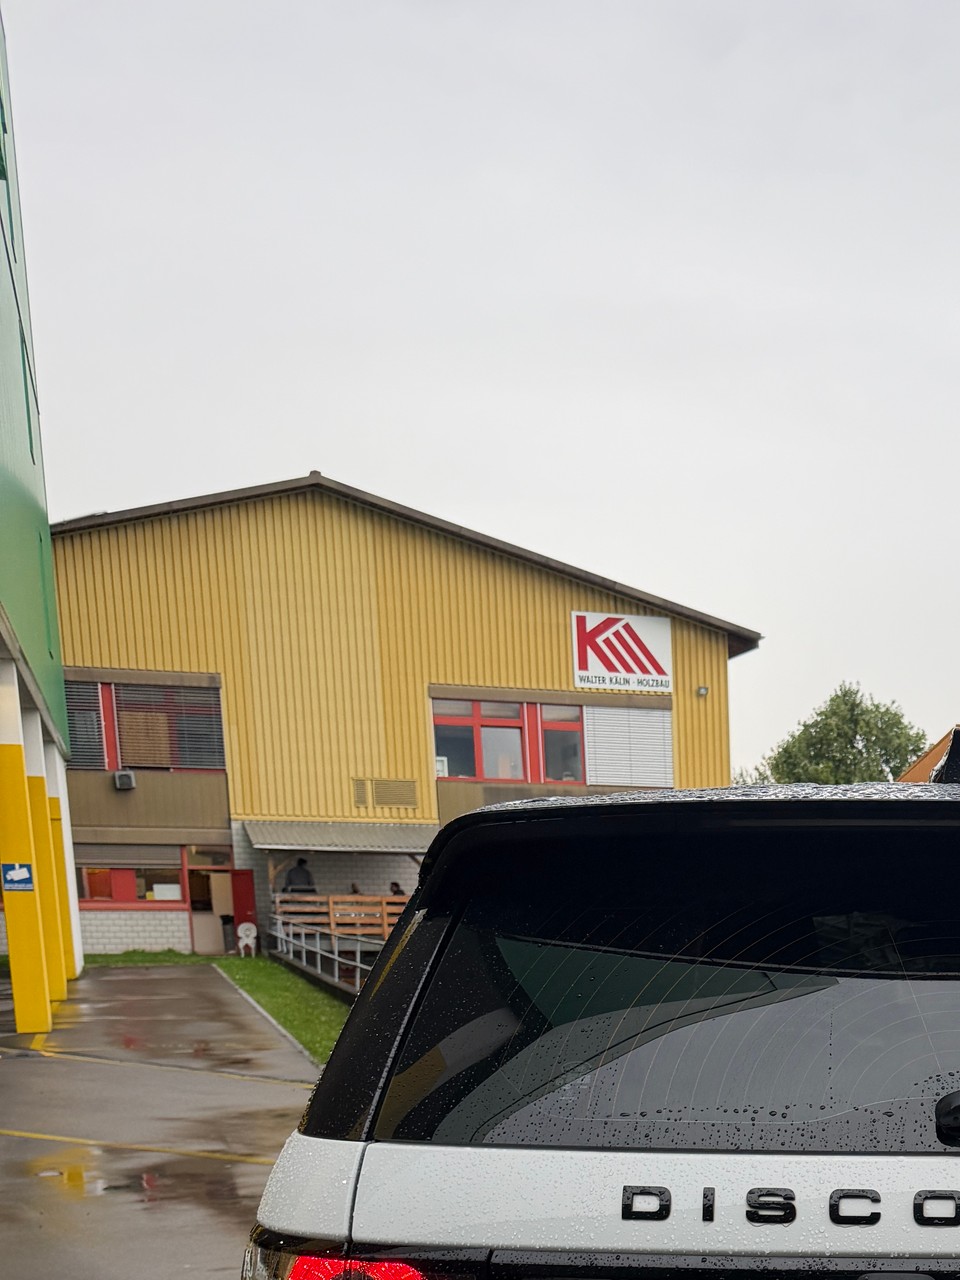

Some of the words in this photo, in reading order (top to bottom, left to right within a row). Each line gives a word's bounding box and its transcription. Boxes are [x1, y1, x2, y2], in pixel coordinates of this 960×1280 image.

[578, 675, 607, 685] WALTER
[609, 675, 631, 686] KÄLIN
[636, 678, 670, 689] HOLZBAU
